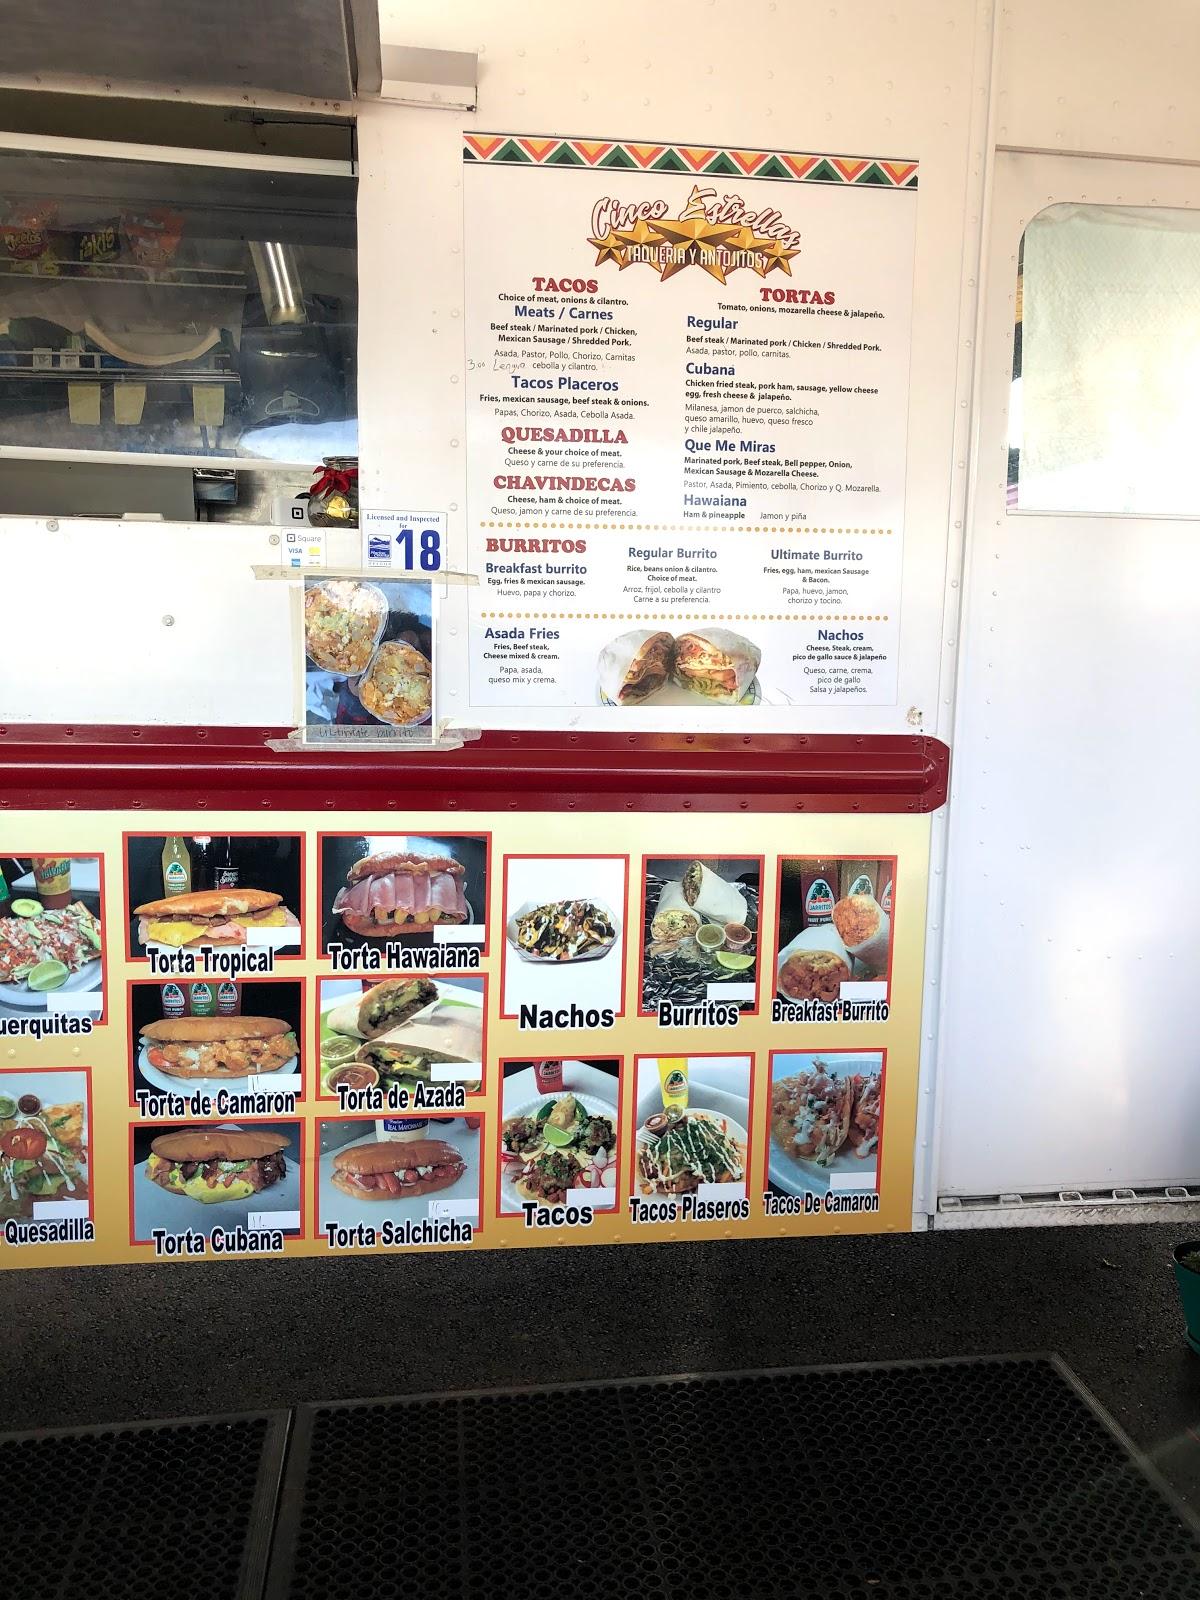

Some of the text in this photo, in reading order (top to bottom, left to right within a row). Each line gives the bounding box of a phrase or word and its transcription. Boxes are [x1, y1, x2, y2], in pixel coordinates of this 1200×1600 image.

[591, 186, 800, 249] Cinco Estrellas
[627, 245, 763, 267] TAQUERIA Y ANTOJITOS
[532, 277, 598, 294] TACOS
[498, 293, 525, 302] Choice
[527, 294, 535, 302] of
[561, 296, 587, 304] onions
[597, 297, 628, 306] cilantro.
[760, 288, 835, 306] TORTAS
[515, 305, 613, 320] Meats / Carnes
[717, 303, 885, 319] Tomato, onions, mozarella cheese & jalapeño.
[491, 323, 508, 331] Beef
[538, 325, 578, 333] Marinated
[580, 326, 598, 335] pork
[605, 327, 637, 336] Chicken,
[688, 316, 738, 332] Regular
[498, 334, 531, 342] Mexican
[533, 335, 566, 346] Sausage
[572, 337, 610, 345] Shredded
[612, 338, 631, 346] Pork.
[494, 349, 635, 362] Asada, Pastor, Pollo, Chorizo, Carnitas
[686, 362, 735, 376] Cubana
[511, 376, 618, 391] Tacos Placeros
[685, 379, 878, 394] Chicken fried steak, pork ham, sausage, yellow cheese
[480, 394, 500, 403] Fries,
[503, 395, 535, 403] mexican
[537, 398, 570, 406] sausage,
[573, 397, 590, 405] beef
[614, 398, 620, 406] &
[621, 399, 649, 407] onions.
[703, 390, 721, 398] fresh
[723, 391, 748, 399] cheese
[758, 393, 792, 402] jalapeño.
[501, 427, 628, 444] QUESADILLA
[508, 447, 536, 455] Cheese
[565, 448, 589, 456] choice
[685, 439, 775, 453] Que Me Miras
[723, 458, 742, 466] pork,
[744, 458, 761, 466] Beef
[762, 459, 783, 467] steak,
[828, 461, 852, 469] Onion,
[493, 475, 636, 492] CHAVINDECAS
[684, 494, 747, 507] Hawaiana
[366, 513, 394, 521] Licensed
[410, 515, 440, 523] Inspected
[297, 535, 322, 543] Square
[486, 538, 586, 554] BURRITOS
[396, 529, 440, 571] 18
[629, 547, 717, 561] Regular Burrito
[771, 549, 863, 561] Ultimate Burrito
[486, 563, 587, 574] Breakfast burrito
[488, 578, 502, 586] Egg,
[485, 627, 559, 639] Asada Fries
[818, 629, 863, 641] Nachos
[817, 654, 833, 662] gallo
[148, 948, 273, 978] Torta Tropical
[329, 944, 479, 969] Torta Hawaiana
[520, 1005, 614, 1028] Nachos
[659, 1002, 738, 1026] Burritos
[772, 1000, 889, 1022] Breakfast Burrito
[138, 1090, 295, 1116] Torta de Camaron
[338, 1084, 465, 1110] Torta de Azada
[630, 1197, 749, 1222] Tacos Plaseros
[764, 1192, 879, 1214] Tacos De Camaron
[522, 1203, 592, 1226] Tacos
[6, 1219, 94, 1243] Quesadilla
[326, 1219, 472, 1247] Torta Salchicha
[153, 1229, 283, 1254] Torta Cubana
